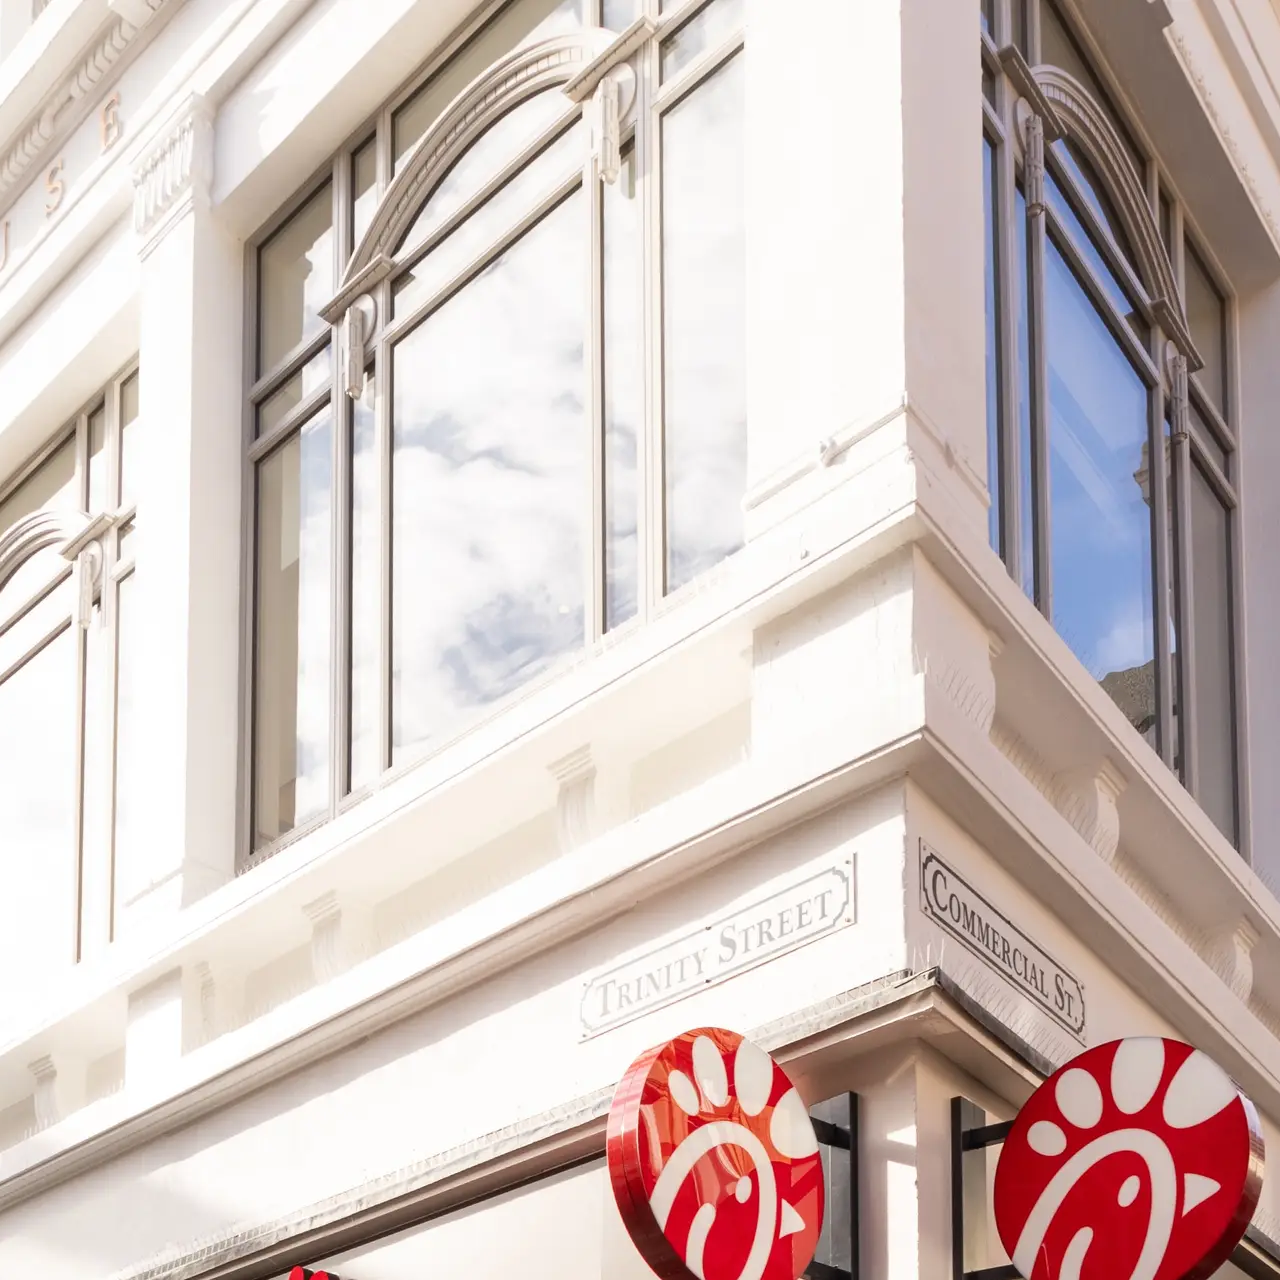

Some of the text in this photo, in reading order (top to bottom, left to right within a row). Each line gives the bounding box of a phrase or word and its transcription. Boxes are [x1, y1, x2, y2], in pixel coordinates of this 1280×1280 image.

[594, 890, 833, 1018] TRINITY STREET
[931, 867, 1078, 1024] COMMERCIAL ST.
